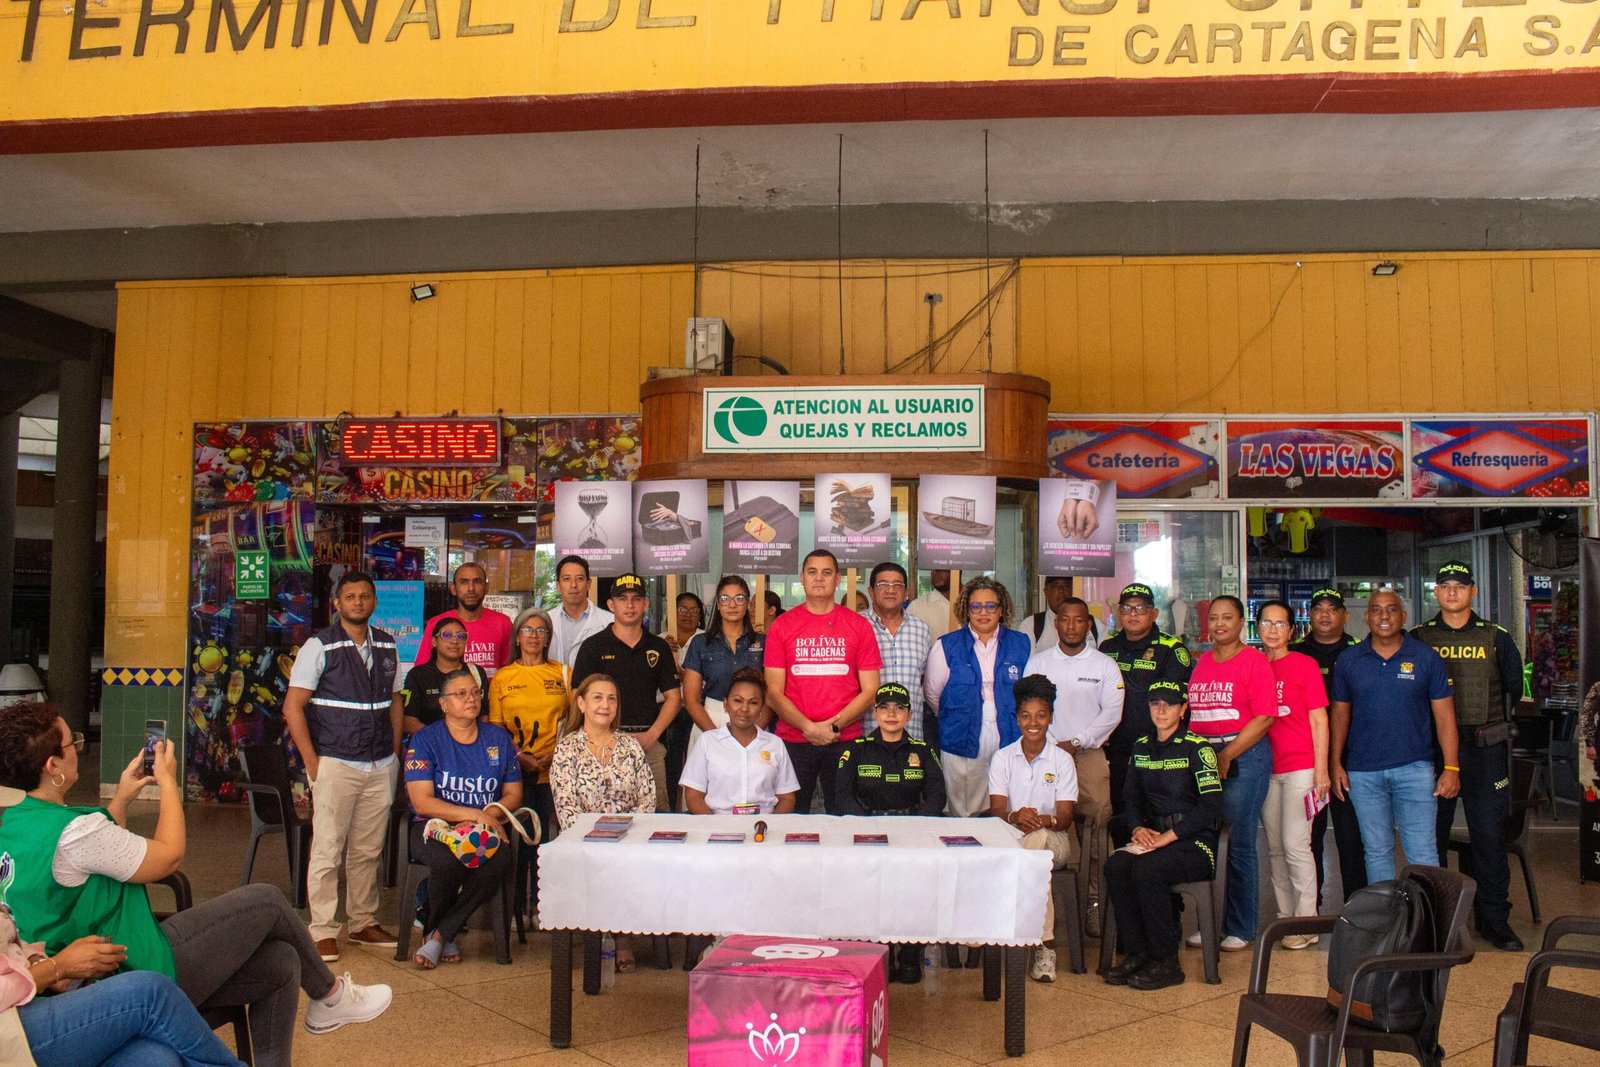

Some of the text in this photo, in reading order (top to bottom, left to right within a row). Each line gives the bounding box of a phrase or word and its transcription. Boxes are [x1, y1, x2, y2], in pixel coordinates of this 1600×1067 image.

[1008, 26, 1090, 66] DE
[1125, 16, 1488, 64] CARTAGENA
[773, 398, 974, 415] ATENCION AL USUARIO
[779, 421, 967, 439] QUEJAS Y RECLAMOS
[344, 424, 496, 458] CASINO
[1087, 452, 1180, 469] Cafetería
[1239, 443, 1395, 477] LAS VEGAS
[1451, 451, 1548, 470] Refresquería
[383, 469, 473, 500] CASINO
[1439, 564, 1469, 574] POLICÍA
[1122, 586, 1149, 595] POLICÍA
[465, 641, 494, 652] LÍVAR
[796, 634, 845, 647] BOLÍVAR
[795, 647, 846, 657] SIN CADENAS
[877, 684, 907, 696] POLICÍA
[1149, 681, 1180, 692] POLICÍA
[1189, 680, 1234, 692] BOLÍVAR
[1188, 692, 1233, 703] SIN CADENAS
[437, 770, 498, 793] Justo
